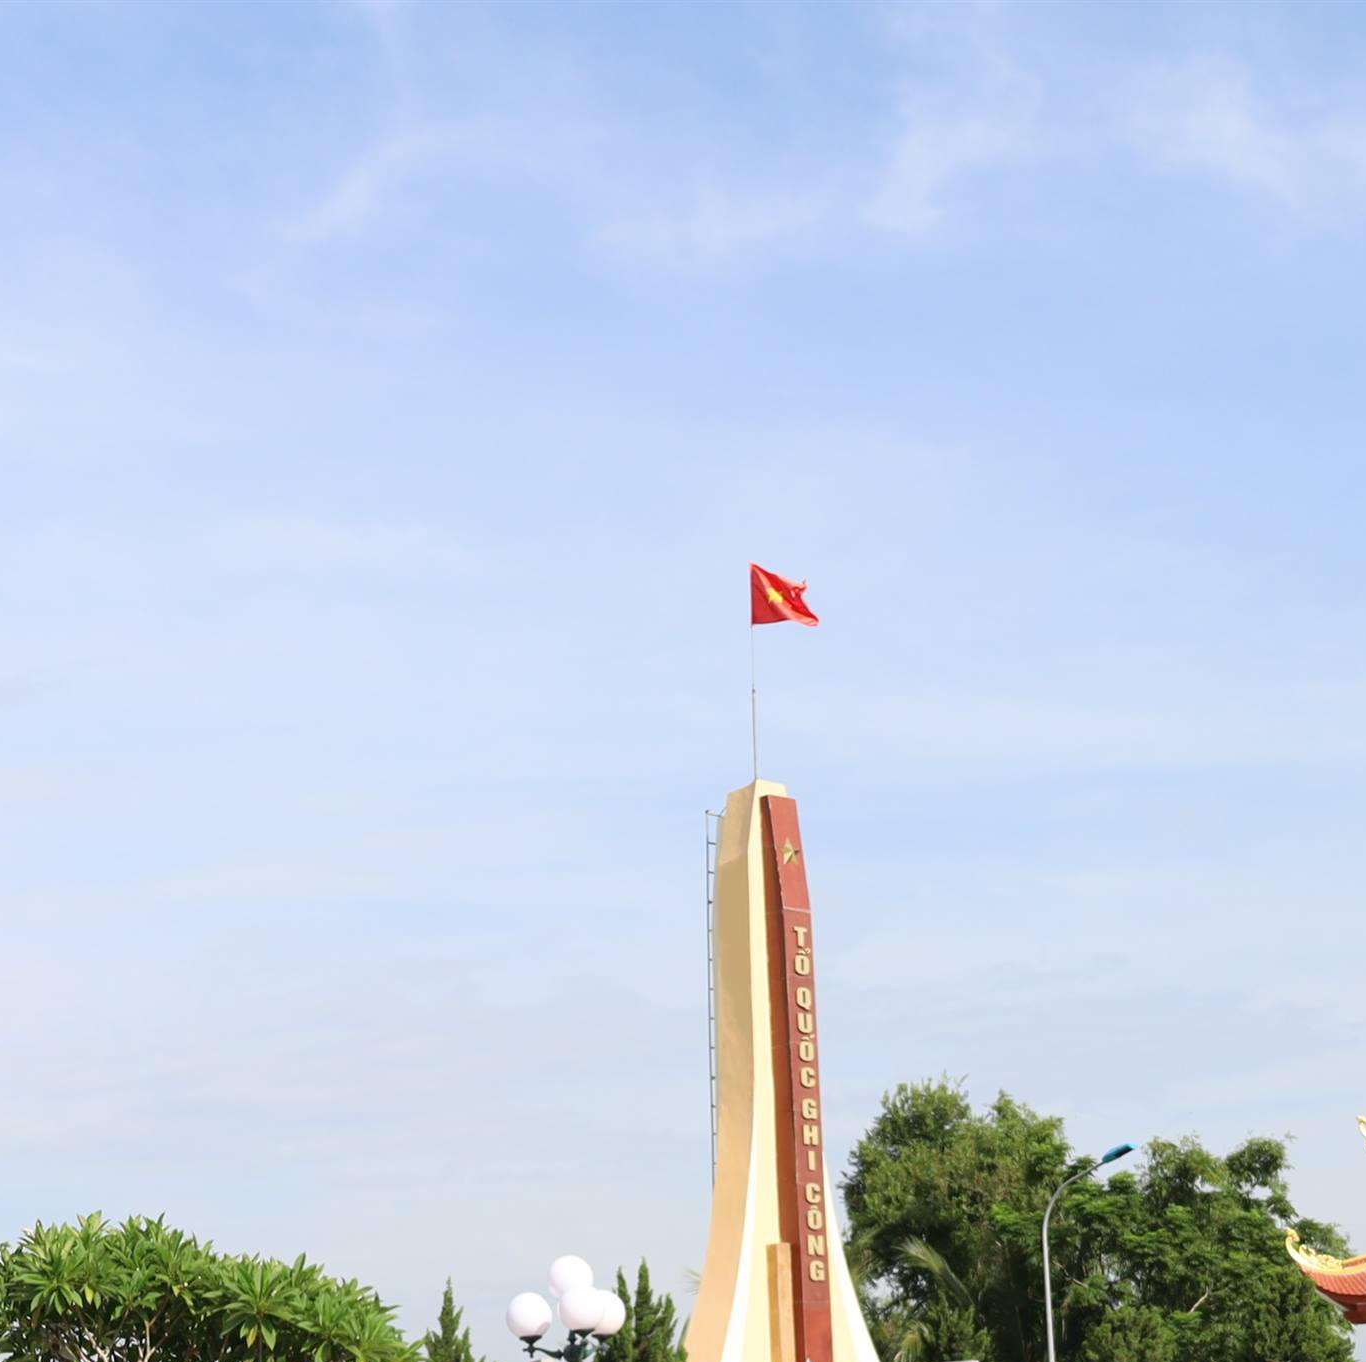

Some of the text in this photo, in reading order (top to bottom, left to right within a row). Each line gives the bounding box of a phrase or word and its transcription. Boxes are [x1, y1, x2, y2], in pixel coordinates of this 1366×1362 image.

[793, 926, 826, 1282] TỔ QUỐC GHI CÔNG
